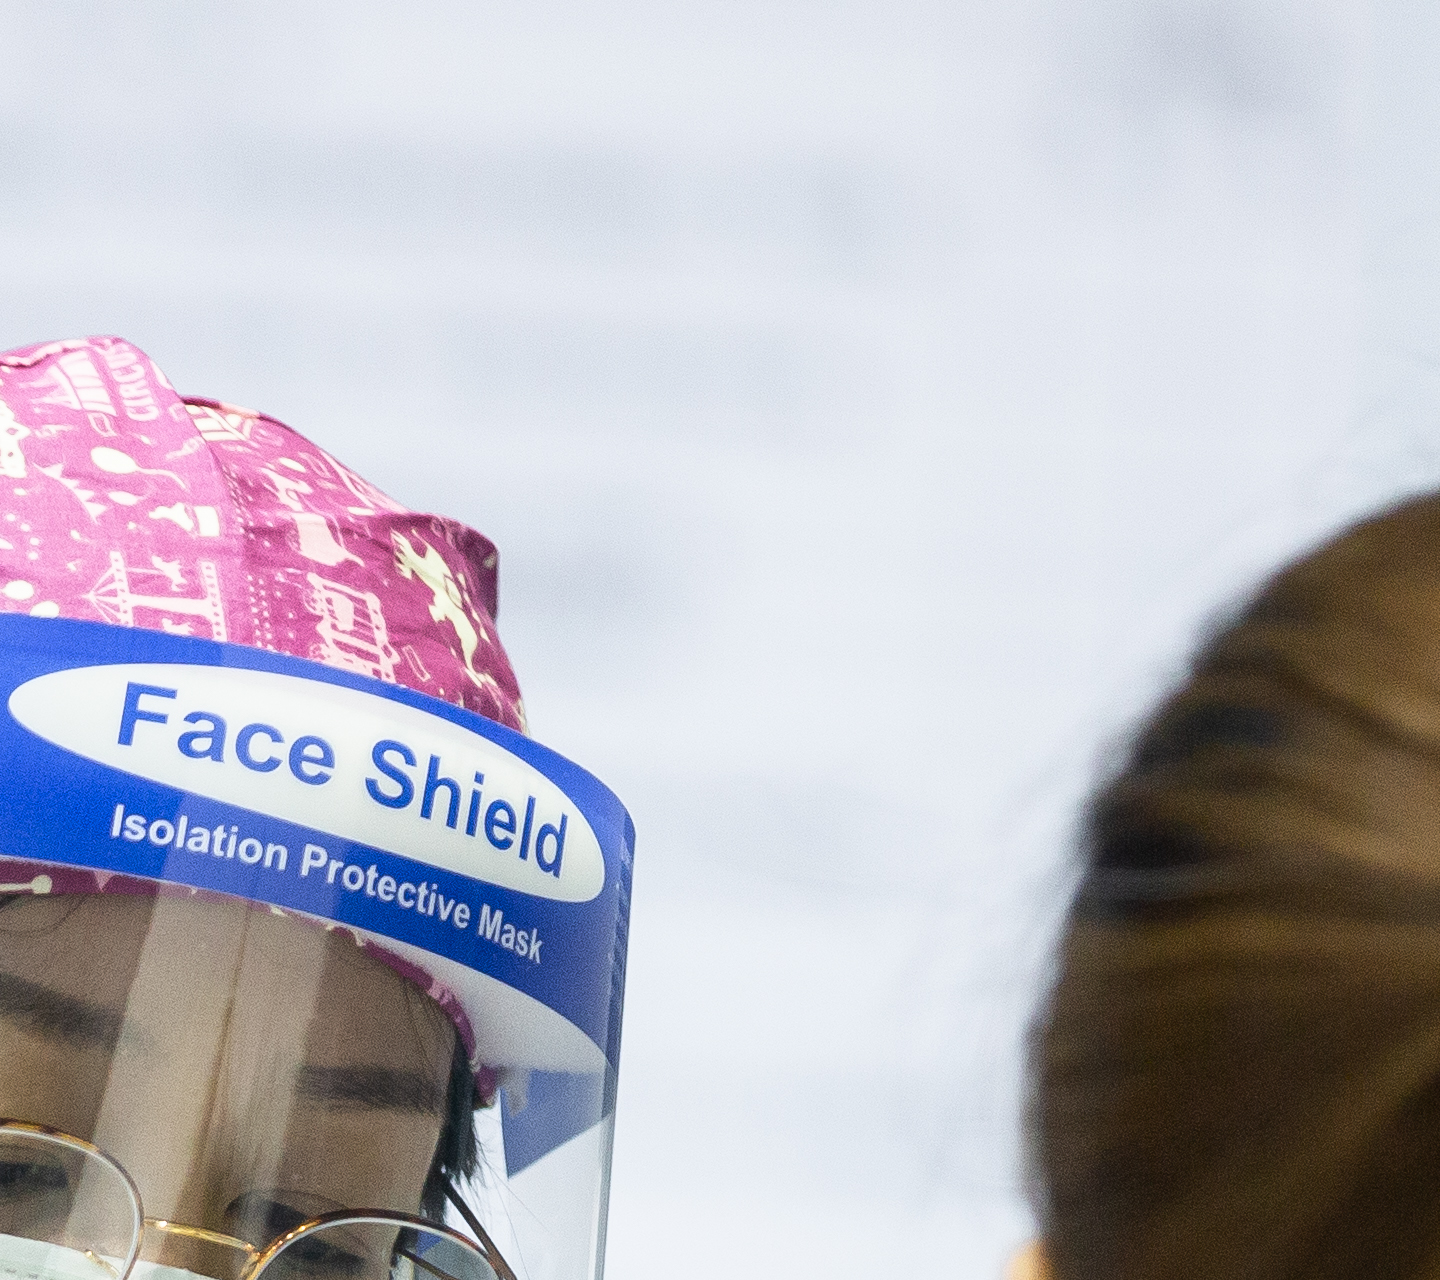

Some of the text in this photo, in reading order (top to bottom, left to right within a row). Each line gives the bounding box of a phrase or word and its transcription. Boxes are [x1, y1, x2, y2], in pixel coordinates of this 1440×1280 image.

[118, 681, 569, 878] Face Shield
[111, 804, 544, 965] Isolation Protective Mask
